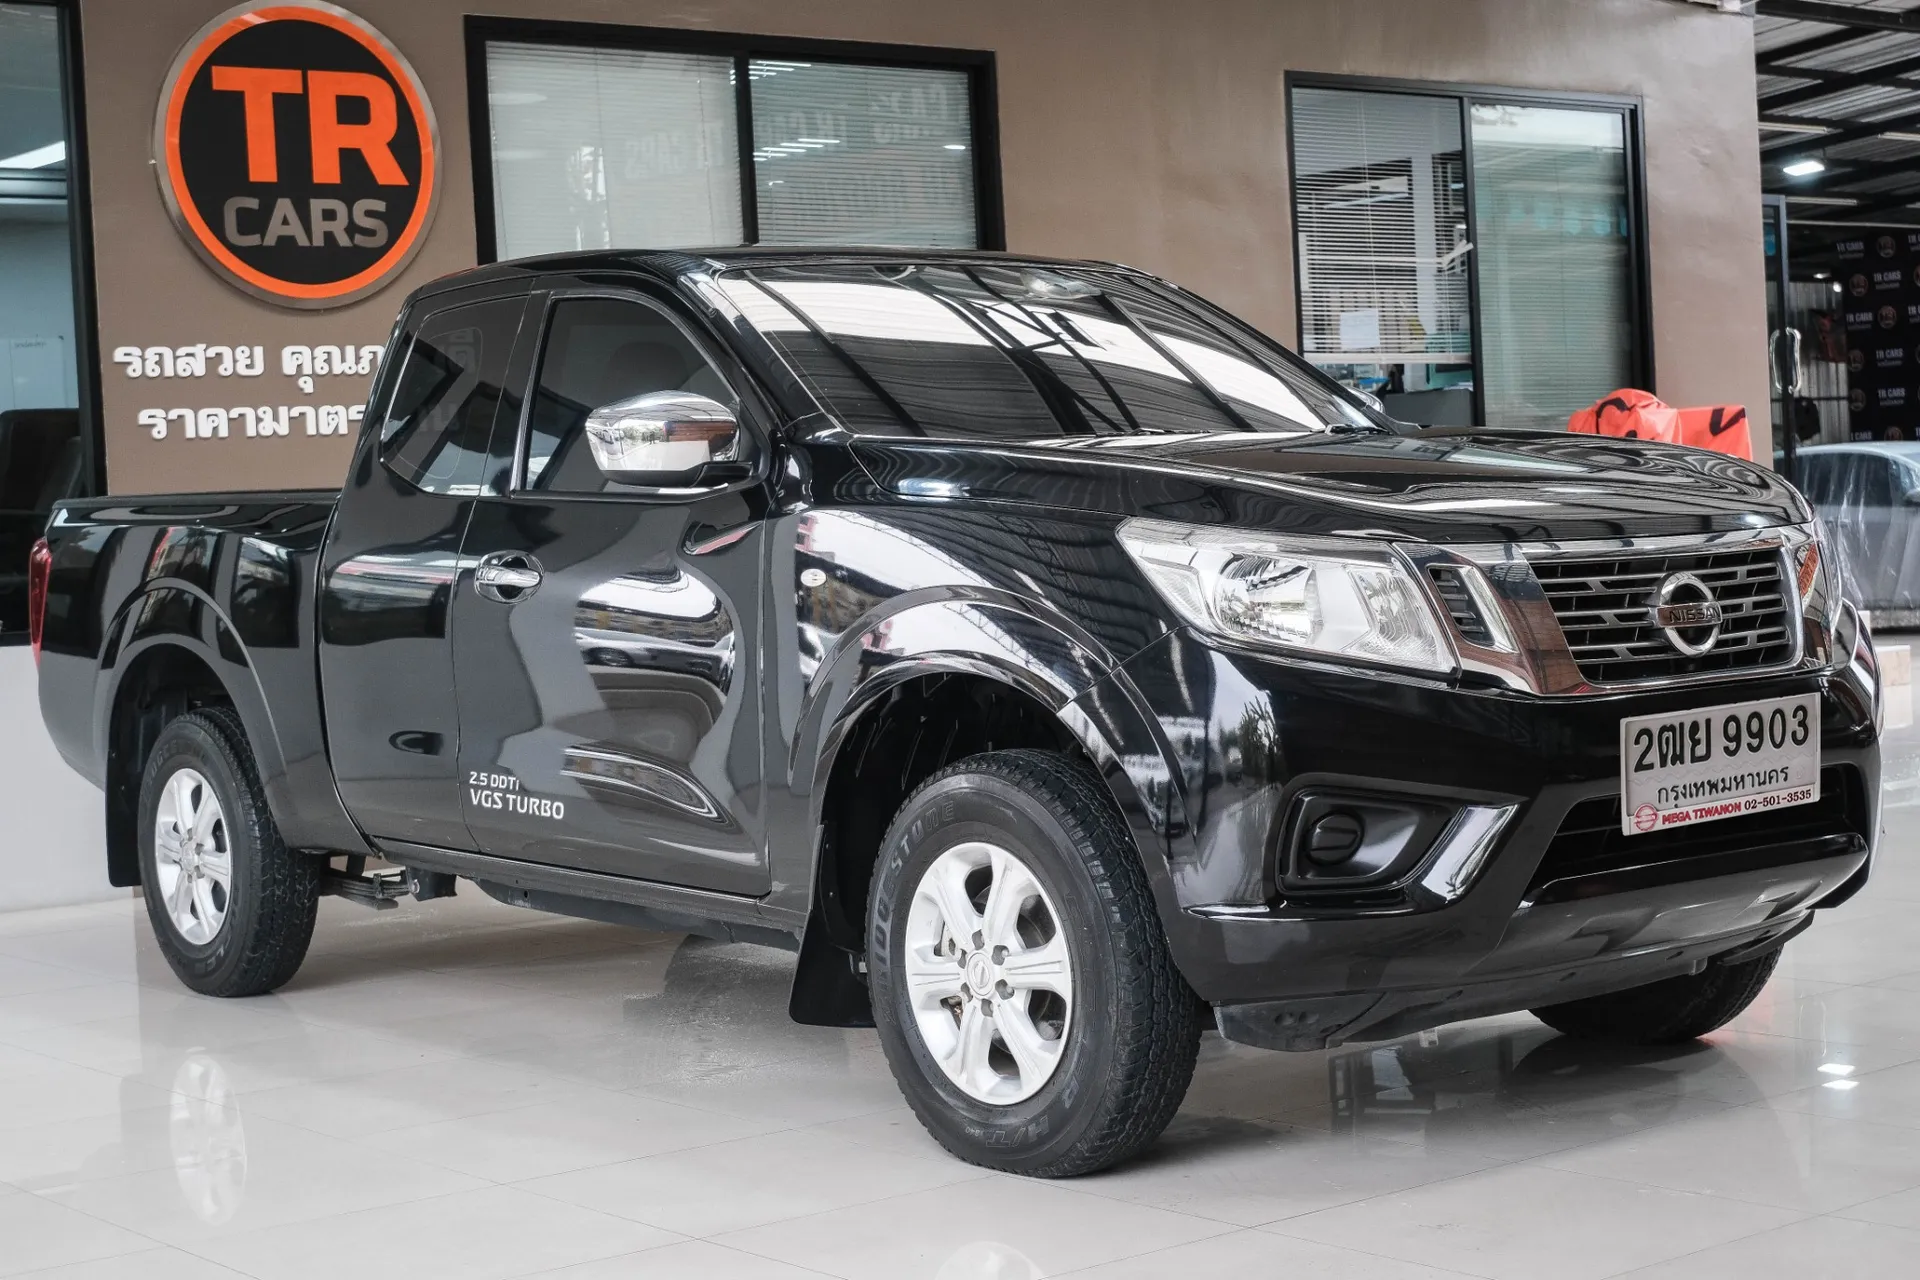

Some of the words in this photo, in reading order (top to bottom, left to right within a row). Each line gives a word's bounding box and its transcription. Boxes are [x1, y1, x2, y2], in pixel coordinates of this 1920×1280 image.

[211, 65, 410, 187] TR
[222, 196, 389, 248] CARS
[113, 343, 264, 378] รถสวย
[1669, 606, 1720, 623] NISSAN
[1633, 717, 1712, 773] 2ฒย
[1722, 705, 1809, 757] 9903
[469, 771, 488, 786] 2.5
[1657, 766, 1789, 808] กรุงเทพมหานคร
[469, 788, 503, 809] VGS
[506, 794, 565, 820] TURBO
[1662, 810, 1692, 825] MEGA
[1693, 801, 1742, 819] TIWANON
[1744, 789, 1812, 811] 02-501-3535
